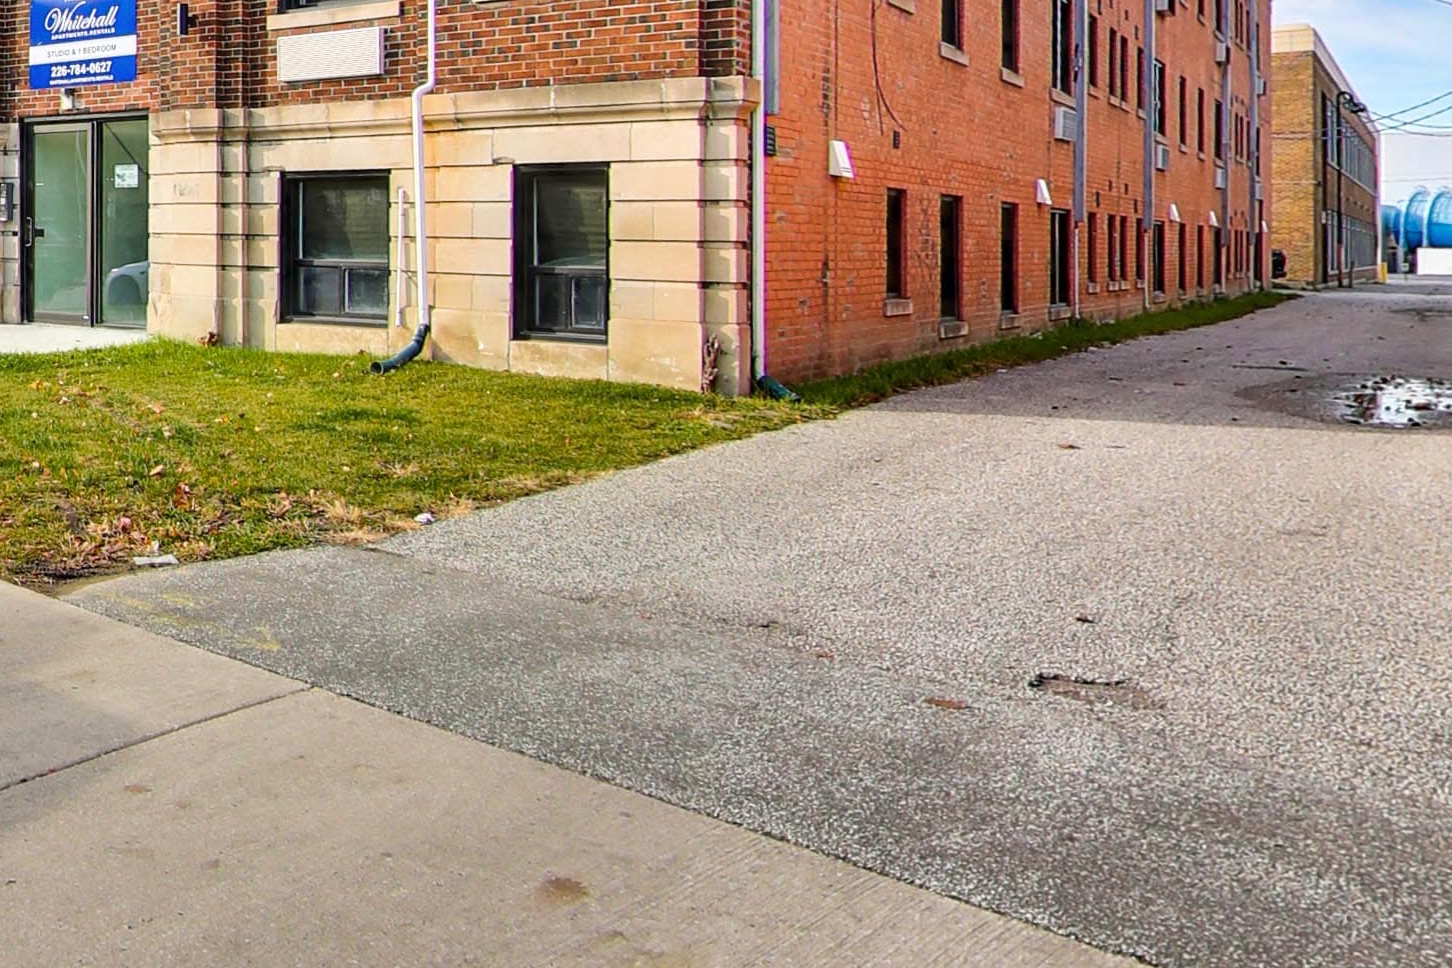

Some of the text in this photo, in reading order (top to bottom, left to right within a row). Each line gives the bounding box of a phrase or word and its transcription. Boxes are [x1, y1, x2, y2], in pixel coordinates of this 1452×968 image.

[44, 1, 119, 33] Whitehall
[47, 49, 70, 58] STUDIO
[83, 44, 117, 54] BEDROOM
